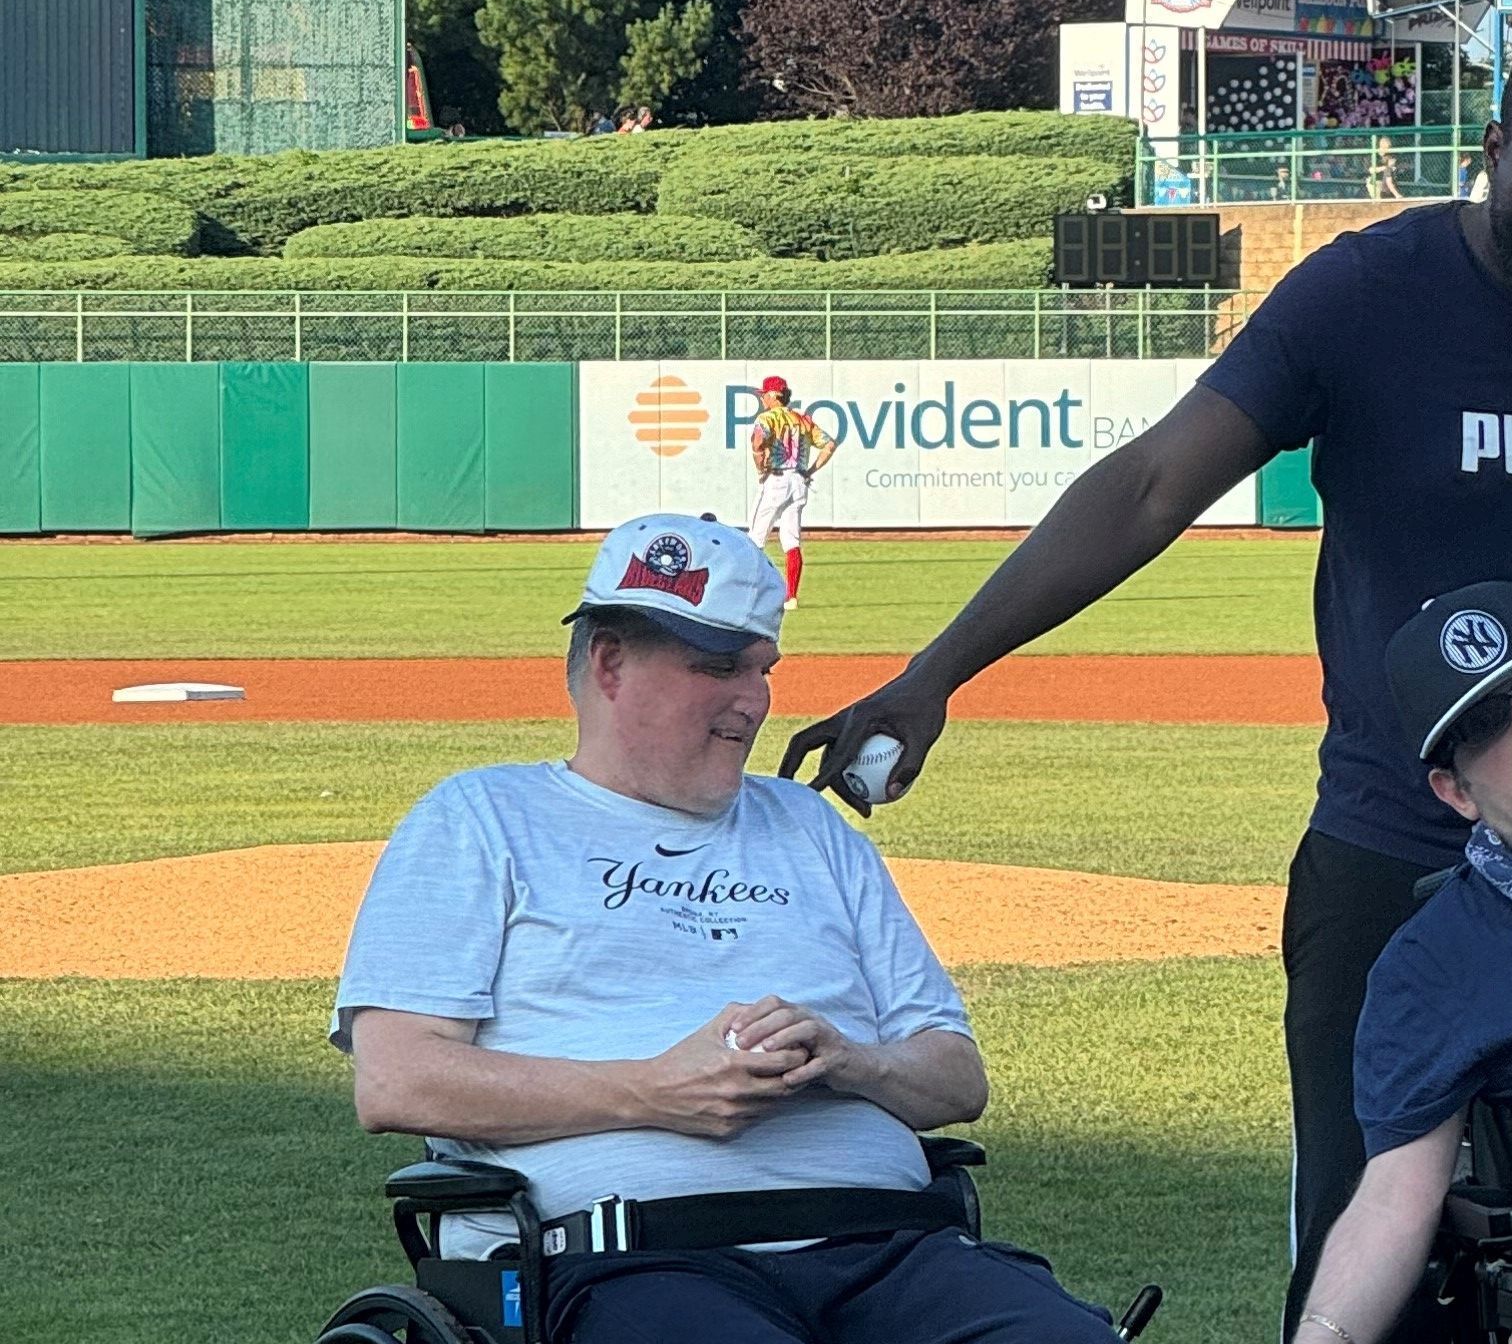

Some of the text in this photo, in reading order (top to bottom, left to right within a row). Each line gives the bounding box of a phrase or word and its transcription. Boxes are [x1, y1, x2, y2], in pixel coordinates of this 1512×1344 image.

[1250, 38, 1268, 52] OF
[1270, 39, 1307, 56] SKILL
[865, 469, 1004, 489] Commitment
[1009, 470, 1048, 492] you
[586, 857, 790, 910] Yankees
